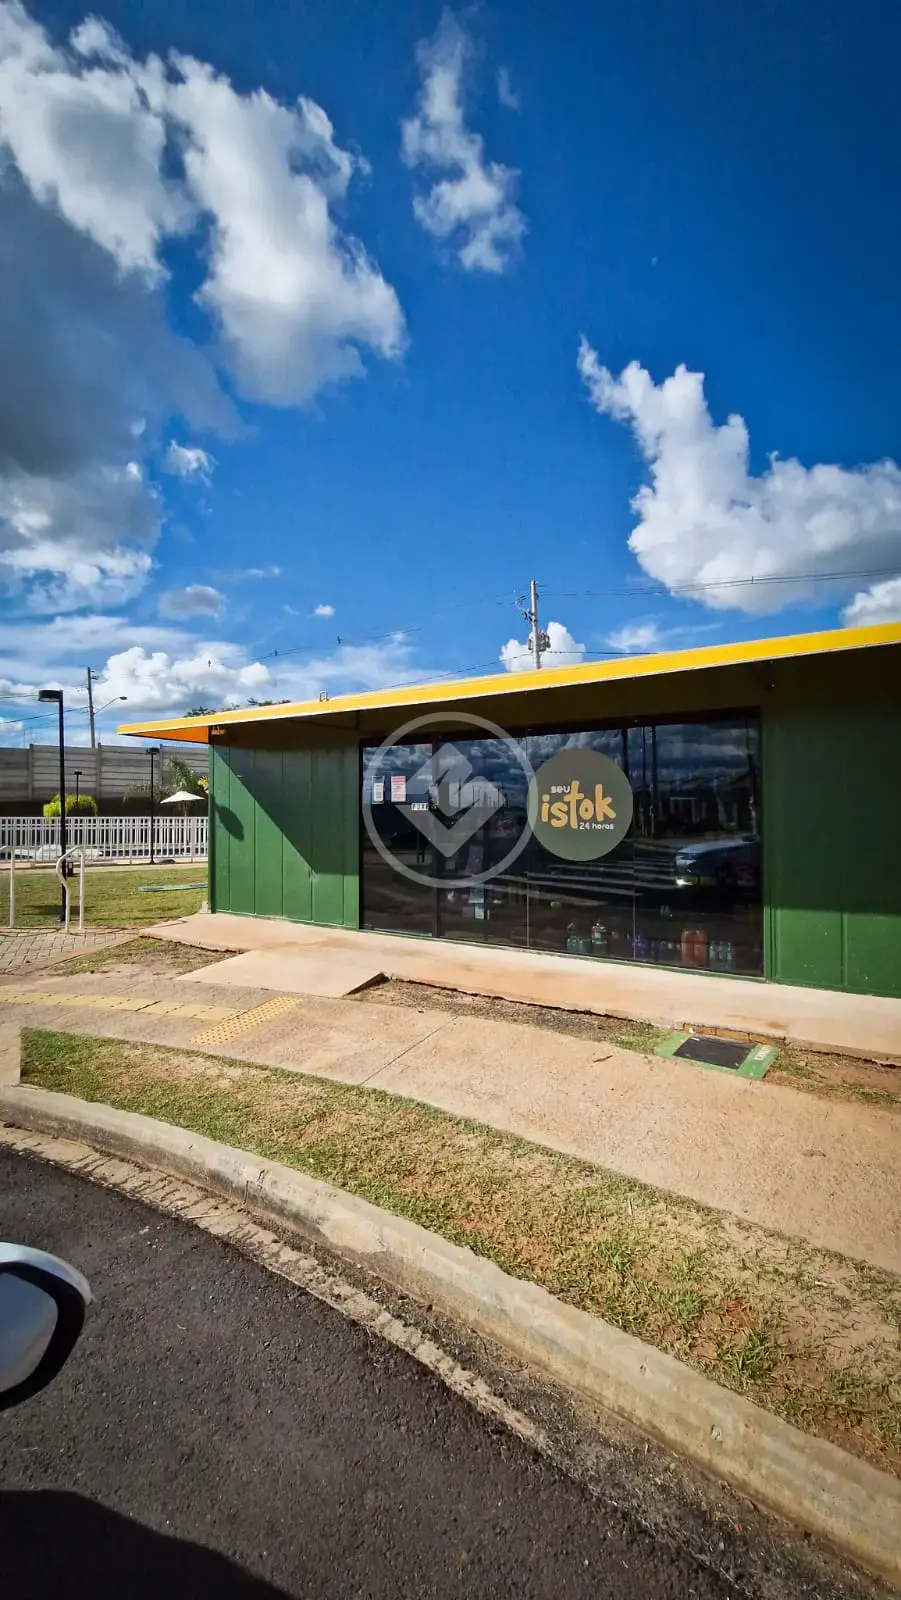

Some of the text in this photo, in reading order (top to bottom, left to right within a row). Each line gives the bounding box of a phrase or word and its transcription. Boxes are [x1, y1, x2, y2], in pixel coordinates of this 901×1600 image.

[550, 785, 571, 794] seu
[541, 780, 617, 829] istok
[579, 822, 614, 830] 24 horas
